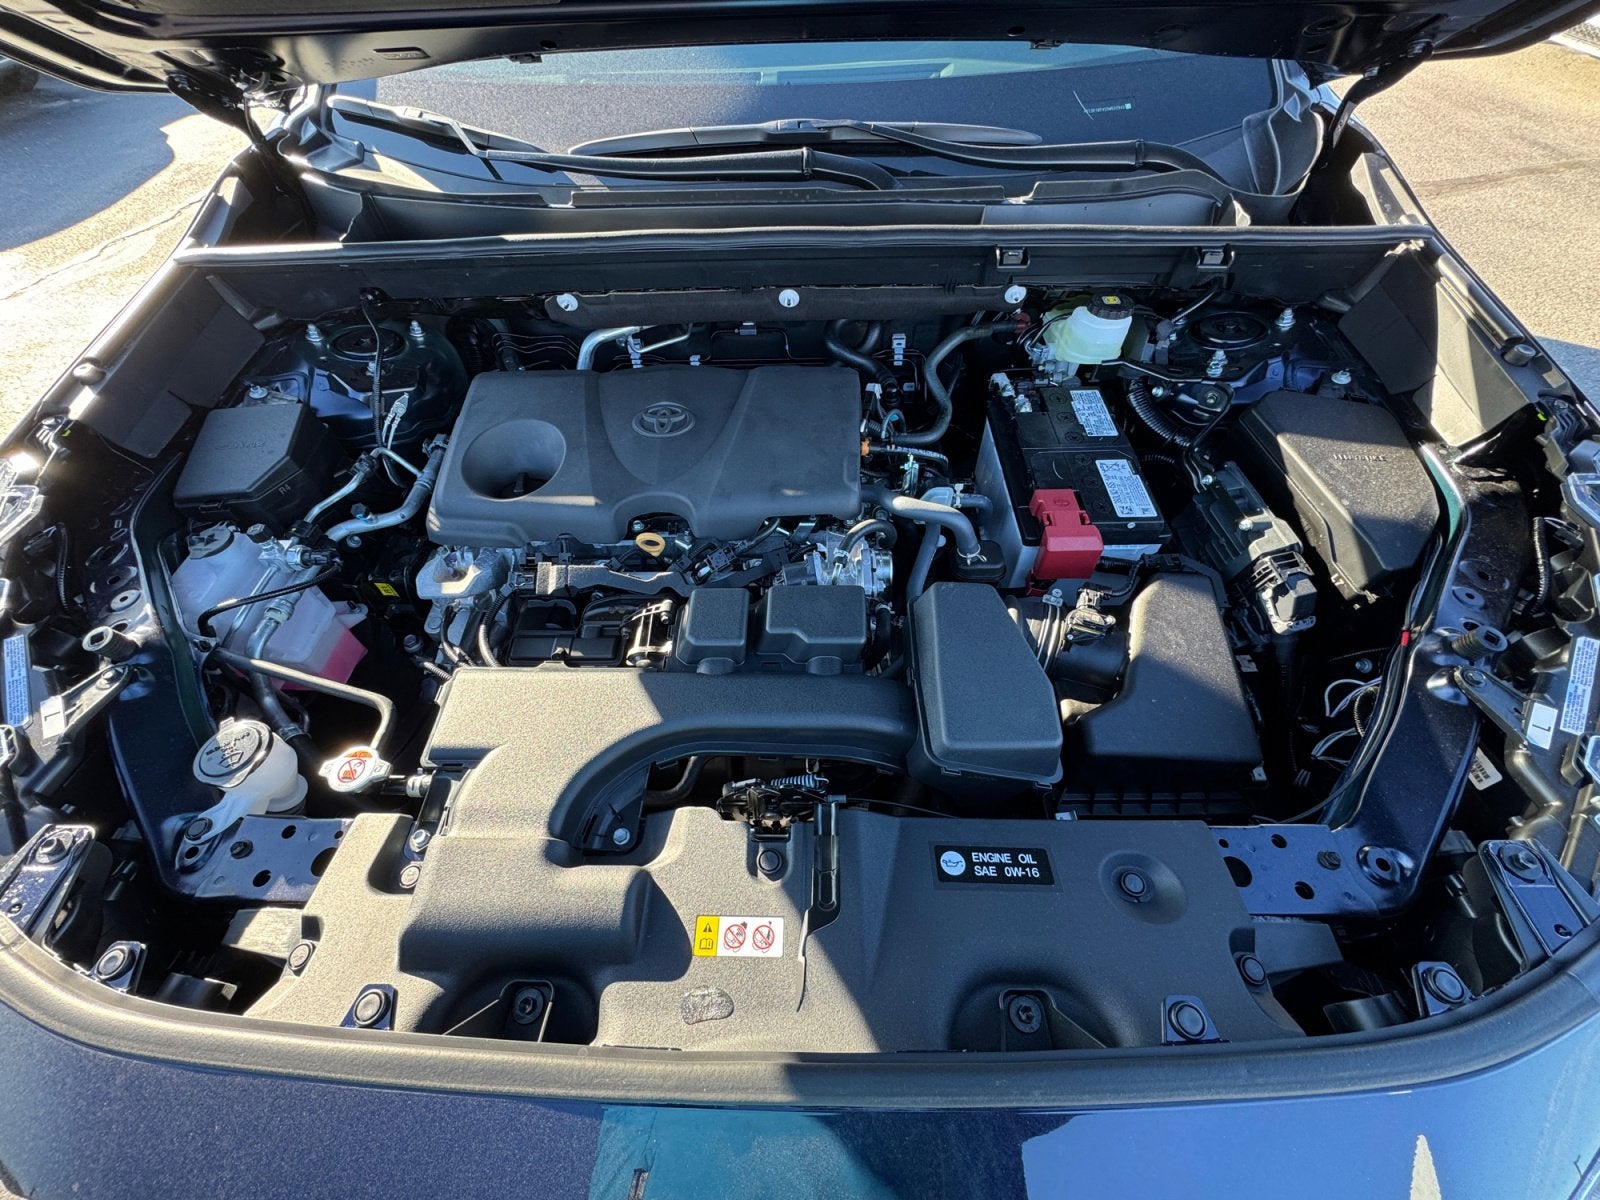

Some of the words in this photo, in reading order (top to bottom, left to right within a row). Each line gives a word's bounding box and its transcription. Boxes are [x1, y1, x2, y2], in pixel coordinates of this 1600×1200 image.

[971, 852, 1012, 864] ENGINE
[1018, 853, 1037, 865] OIL
[974, 865, 998, 877] SAE
[1004, 866, 1040, 878] 0W-16
